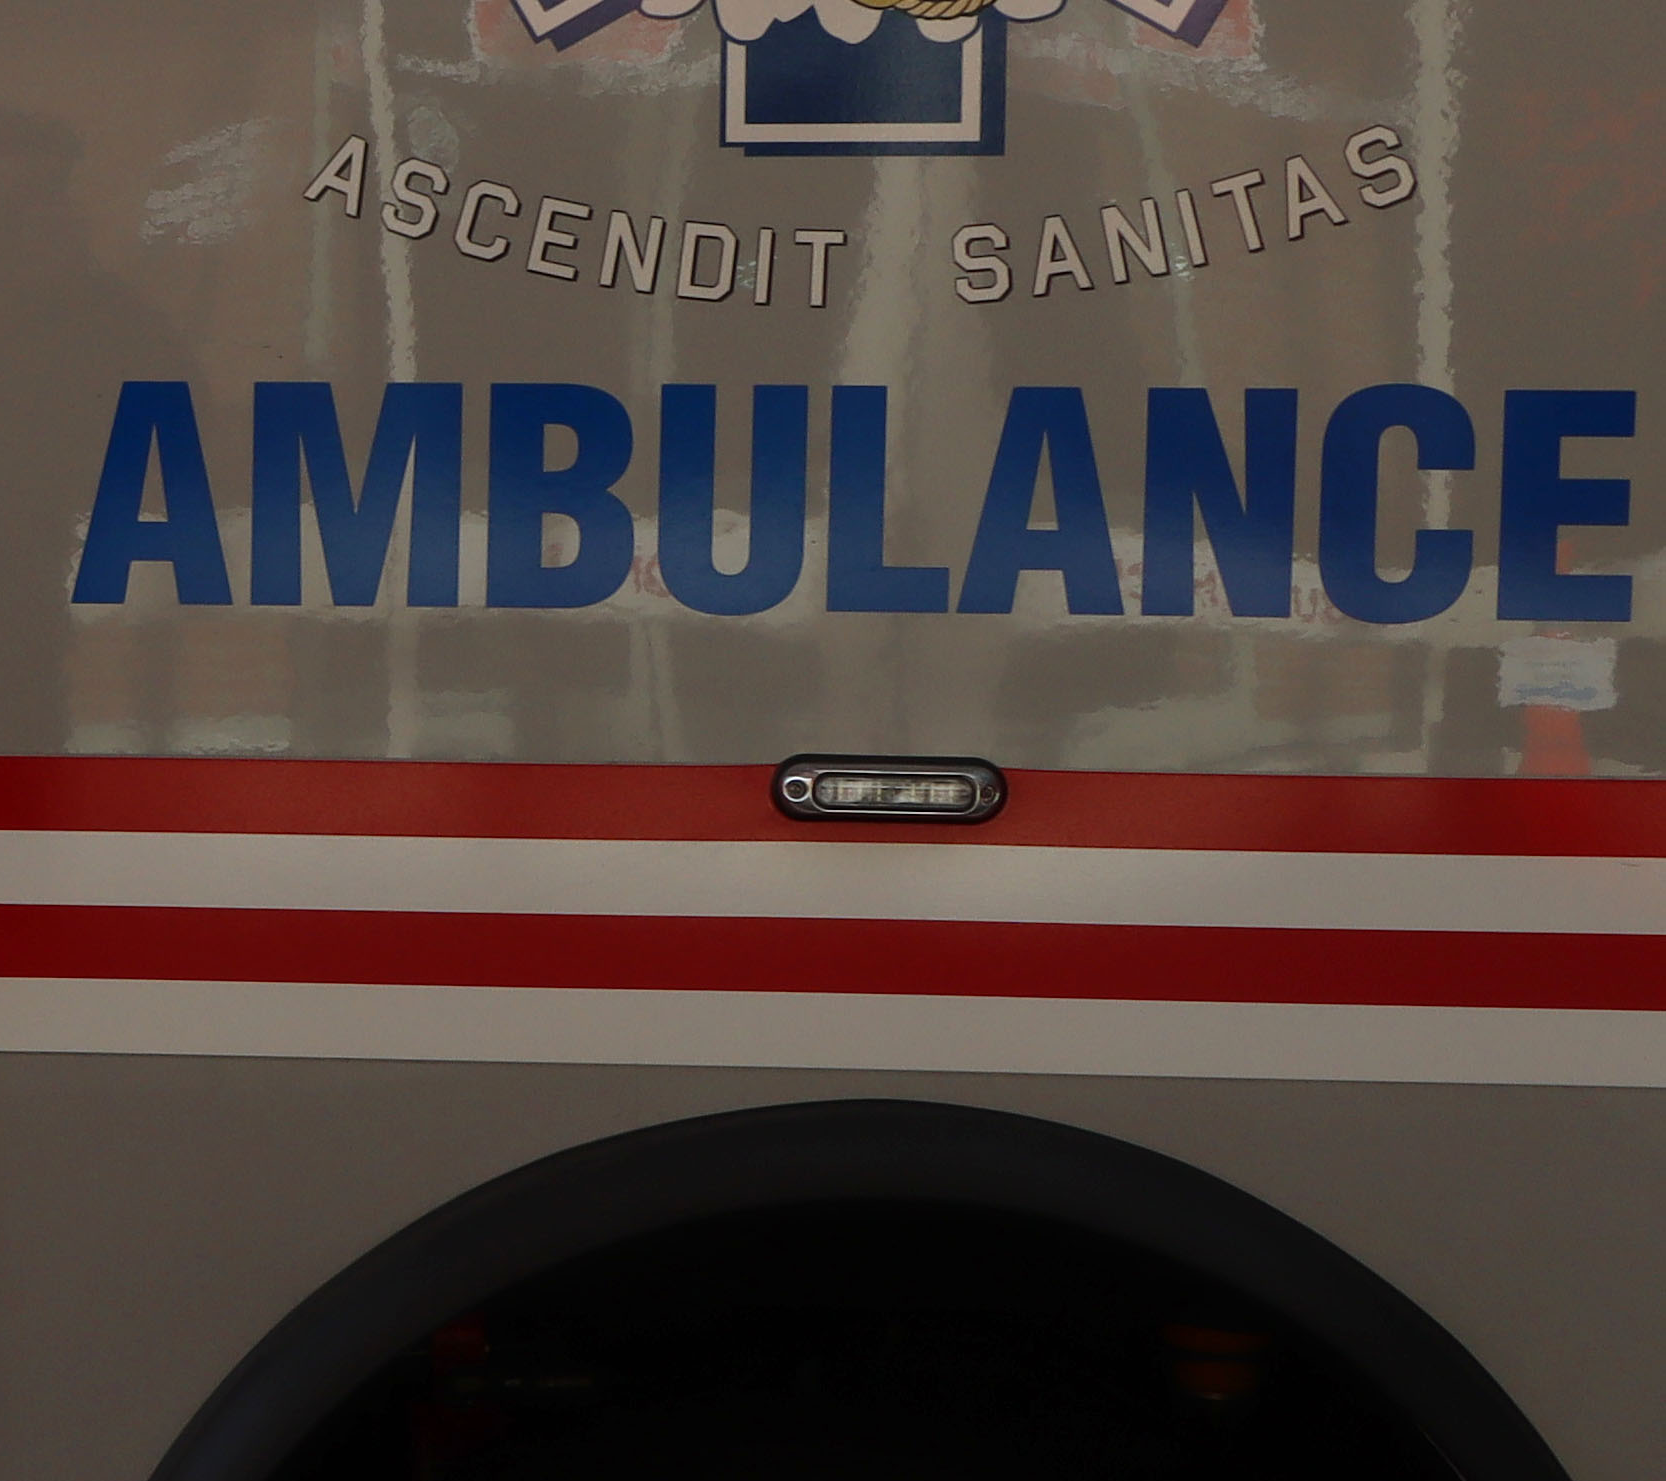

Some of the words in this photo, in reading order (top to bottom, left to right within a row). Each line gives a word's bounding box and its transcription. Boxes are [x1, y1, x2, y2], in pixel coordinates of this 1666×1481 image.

[303, 134, 846, 308] ASCENDIT
[951, 124, 1418, 304] SANITAS
[71, 380, 1638, 623] AMBULANCE
